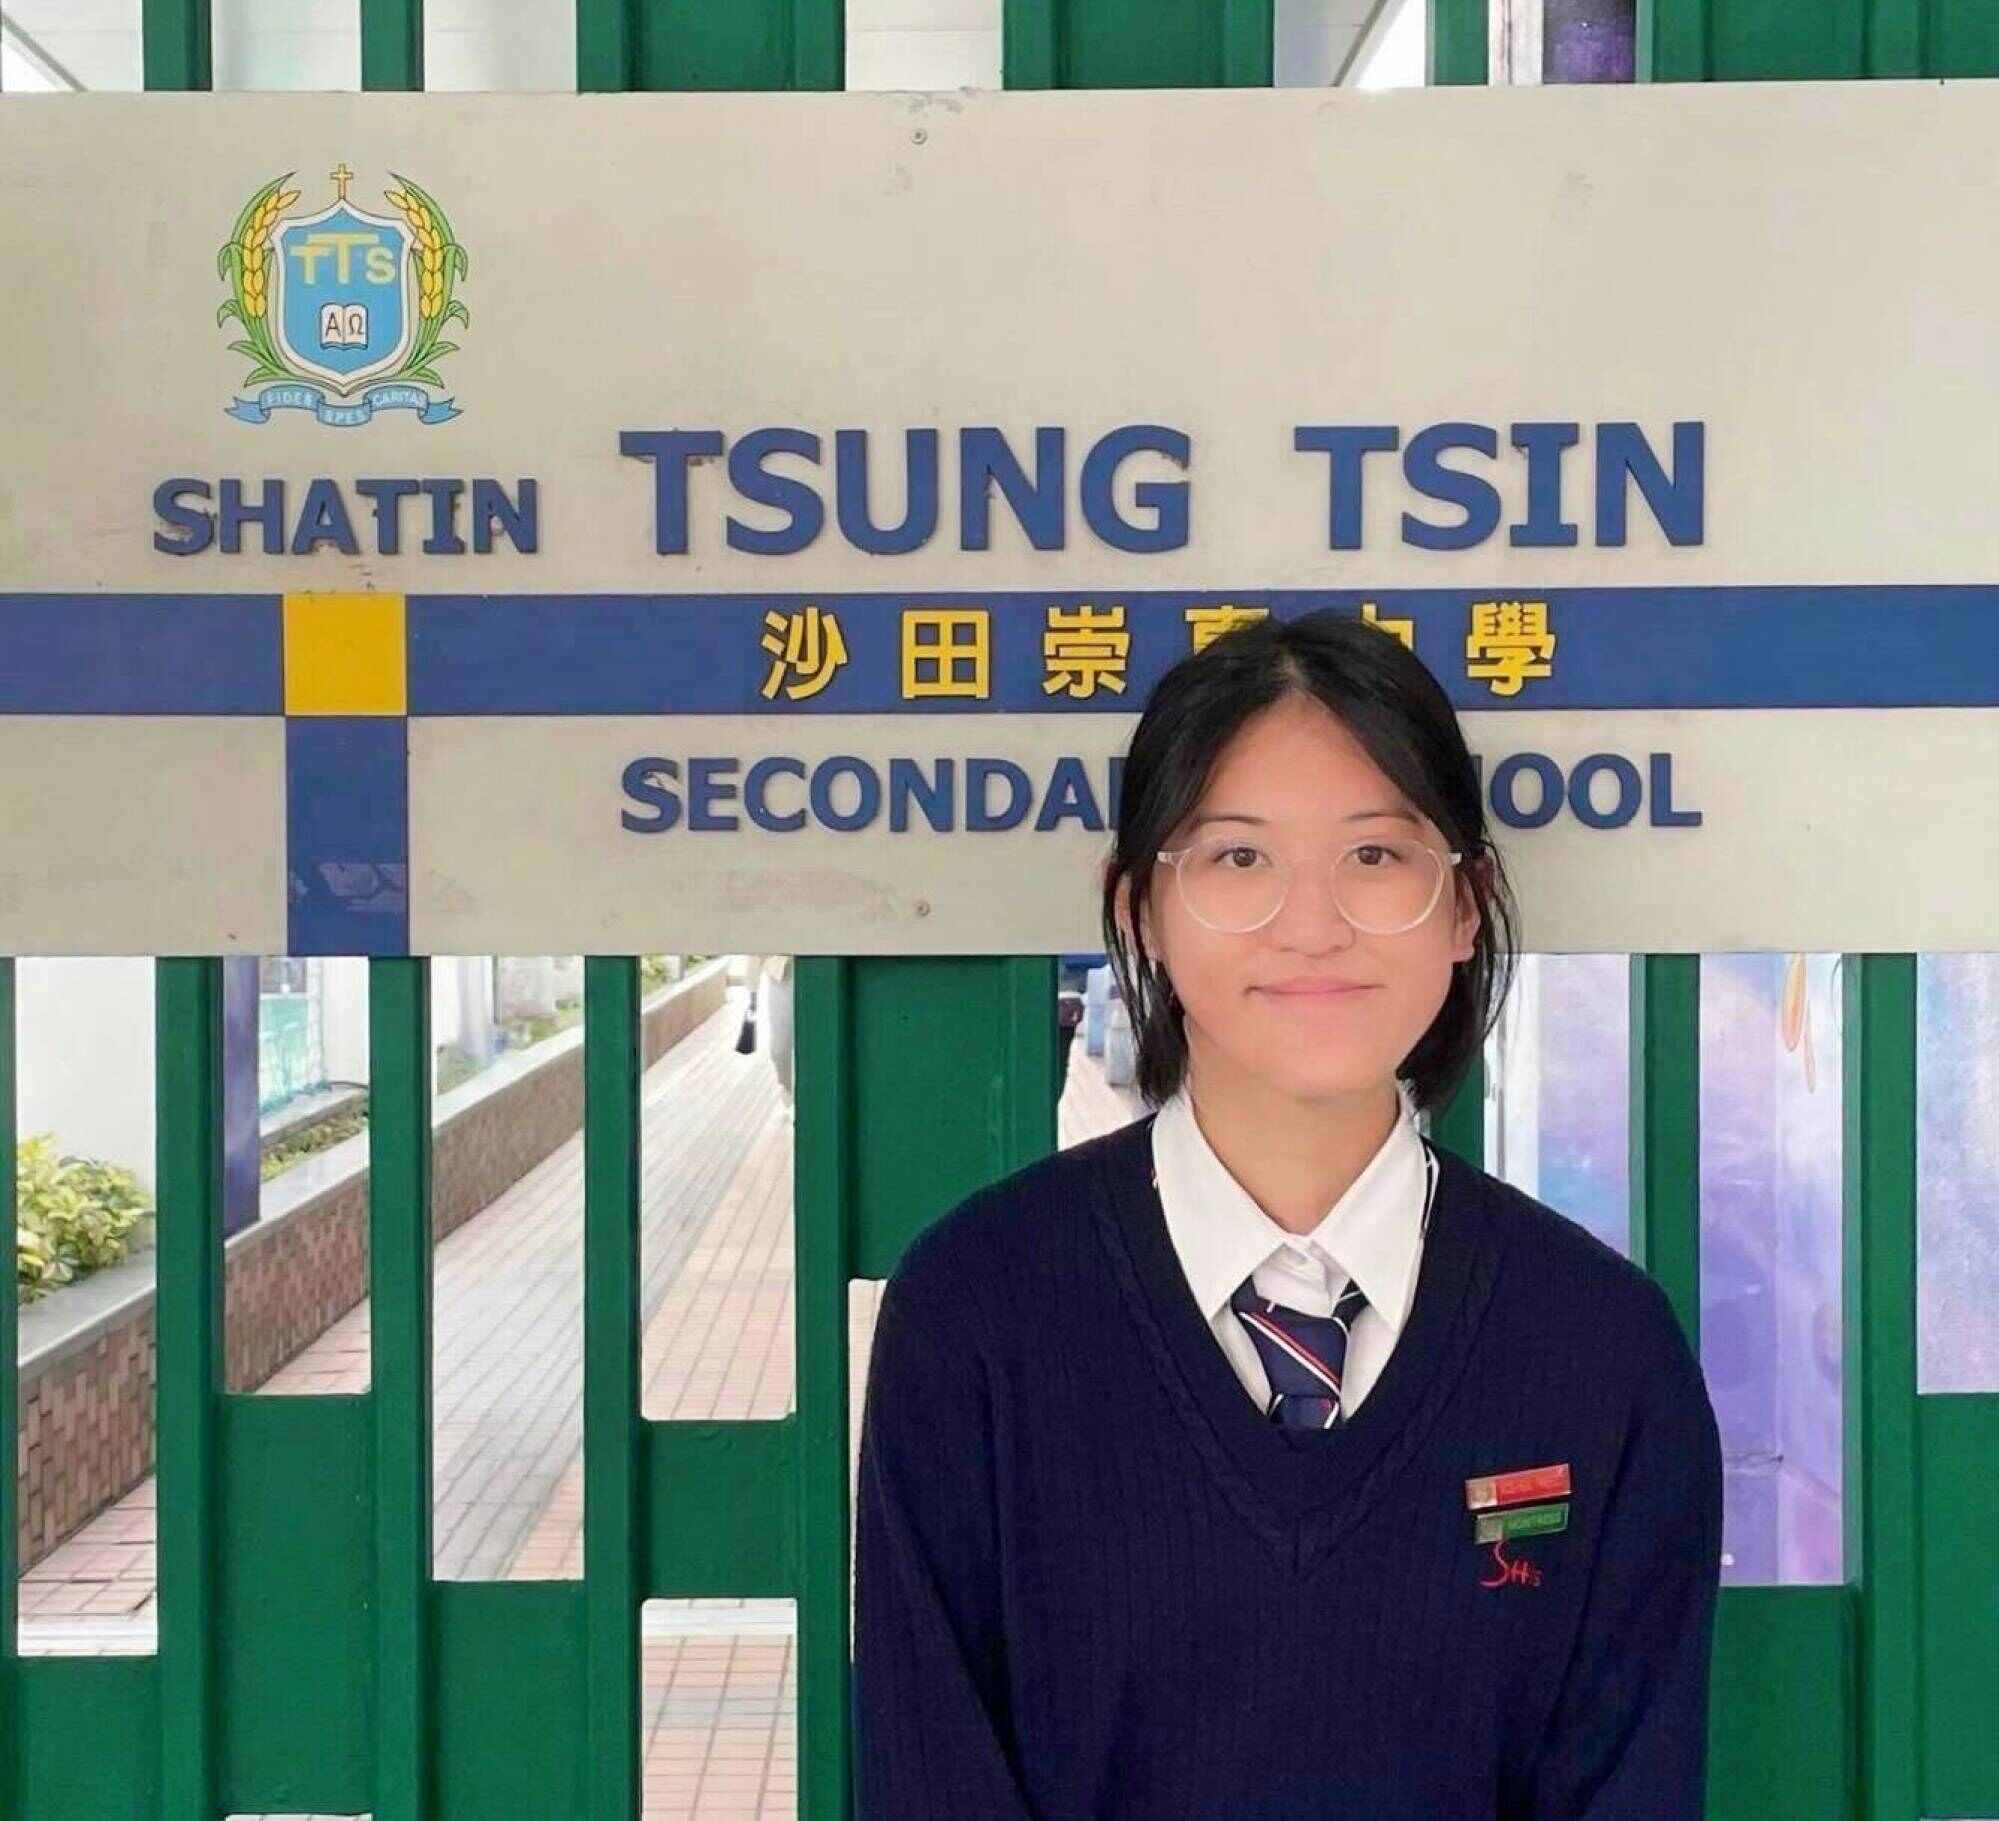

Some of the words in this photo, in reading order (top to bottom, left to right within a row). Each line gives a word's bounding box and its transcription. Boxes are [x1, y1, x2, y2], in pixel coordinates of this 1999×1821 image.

[153, 478, 540, 555] SHATIN
[620, 427, 1192, 556] TSUNG
[1295, 422, 1705, 551] TSIN
[761, 602, 1557, 699] 沙田崇學
[621, 756, 1129, 834] SECONDA
